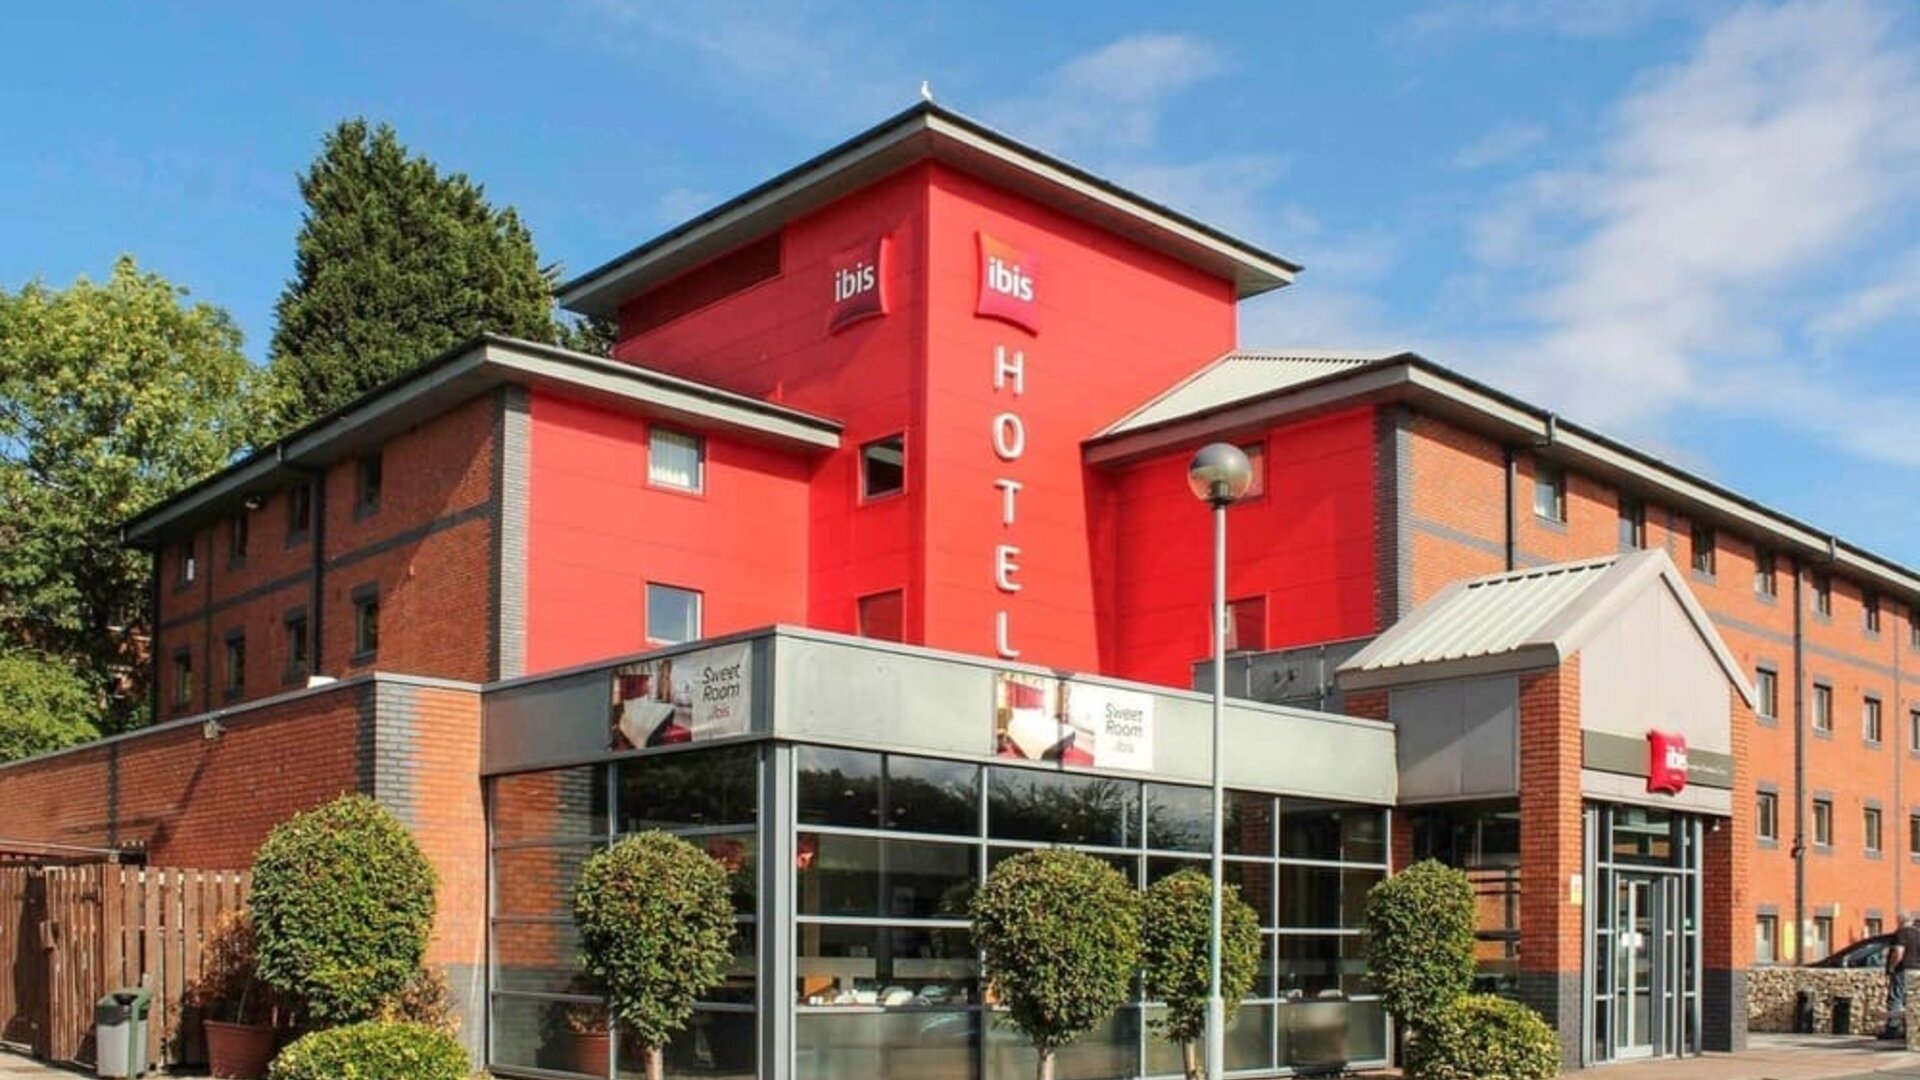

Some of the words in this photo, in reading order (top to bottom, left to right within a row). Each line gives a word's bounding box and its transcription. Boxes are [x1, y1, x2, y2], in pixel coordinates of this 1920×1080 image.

[834, 261, 875, 302] ibis
[988, 256, 1034, 301] ibis
[992, 345, 1026, 658] HOTEL
[702, 664, 741, 684] Sweet
[703, 683, 740, 702] Room
[1105, 702, 1143, 723] Sweet
[1105, 720, 1143, 738] Room
